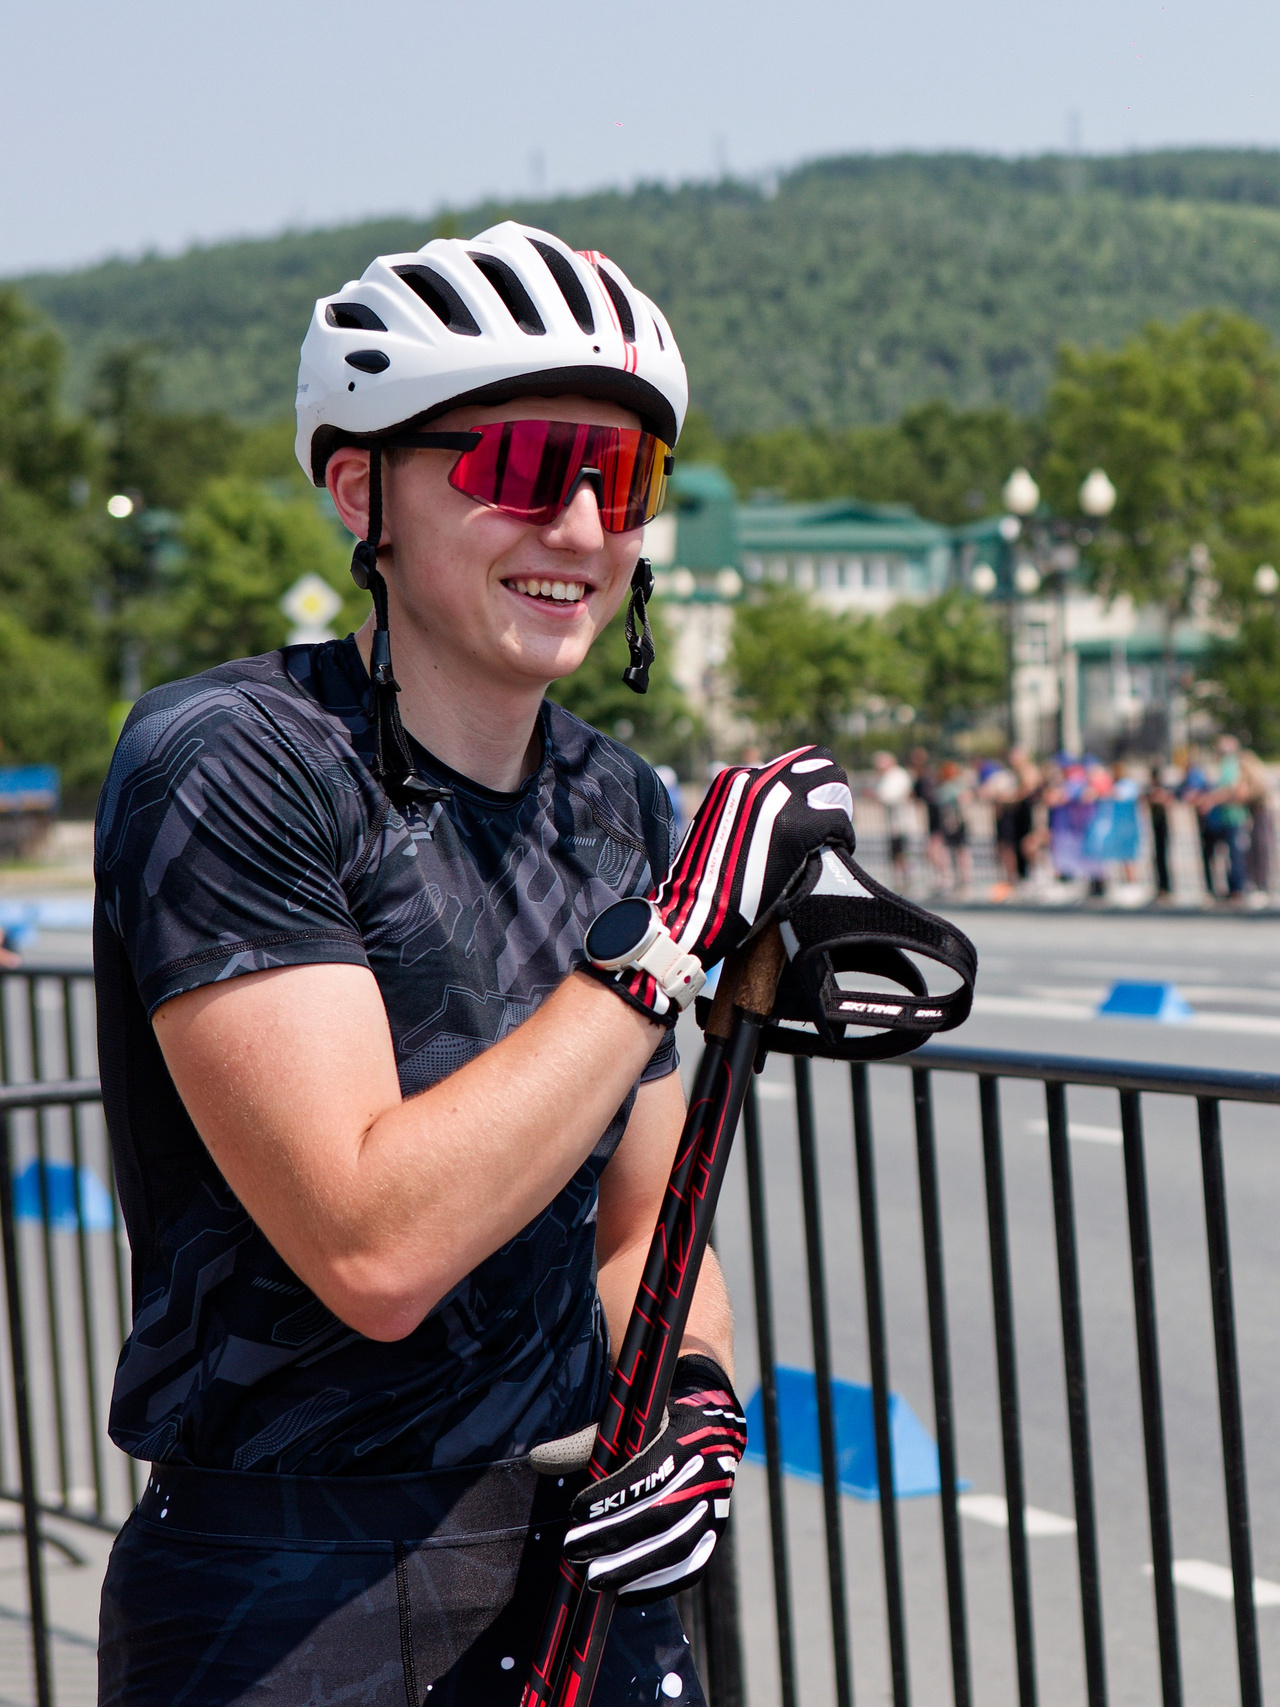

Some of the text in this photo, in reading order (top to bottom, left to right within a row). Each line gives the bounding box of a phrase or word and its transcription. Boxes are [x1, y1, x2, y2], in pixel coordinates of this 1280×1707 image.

[839, 1001, 903, 1016] SKI TIME
[589, 1454, 676, 1519] SKI TIME
